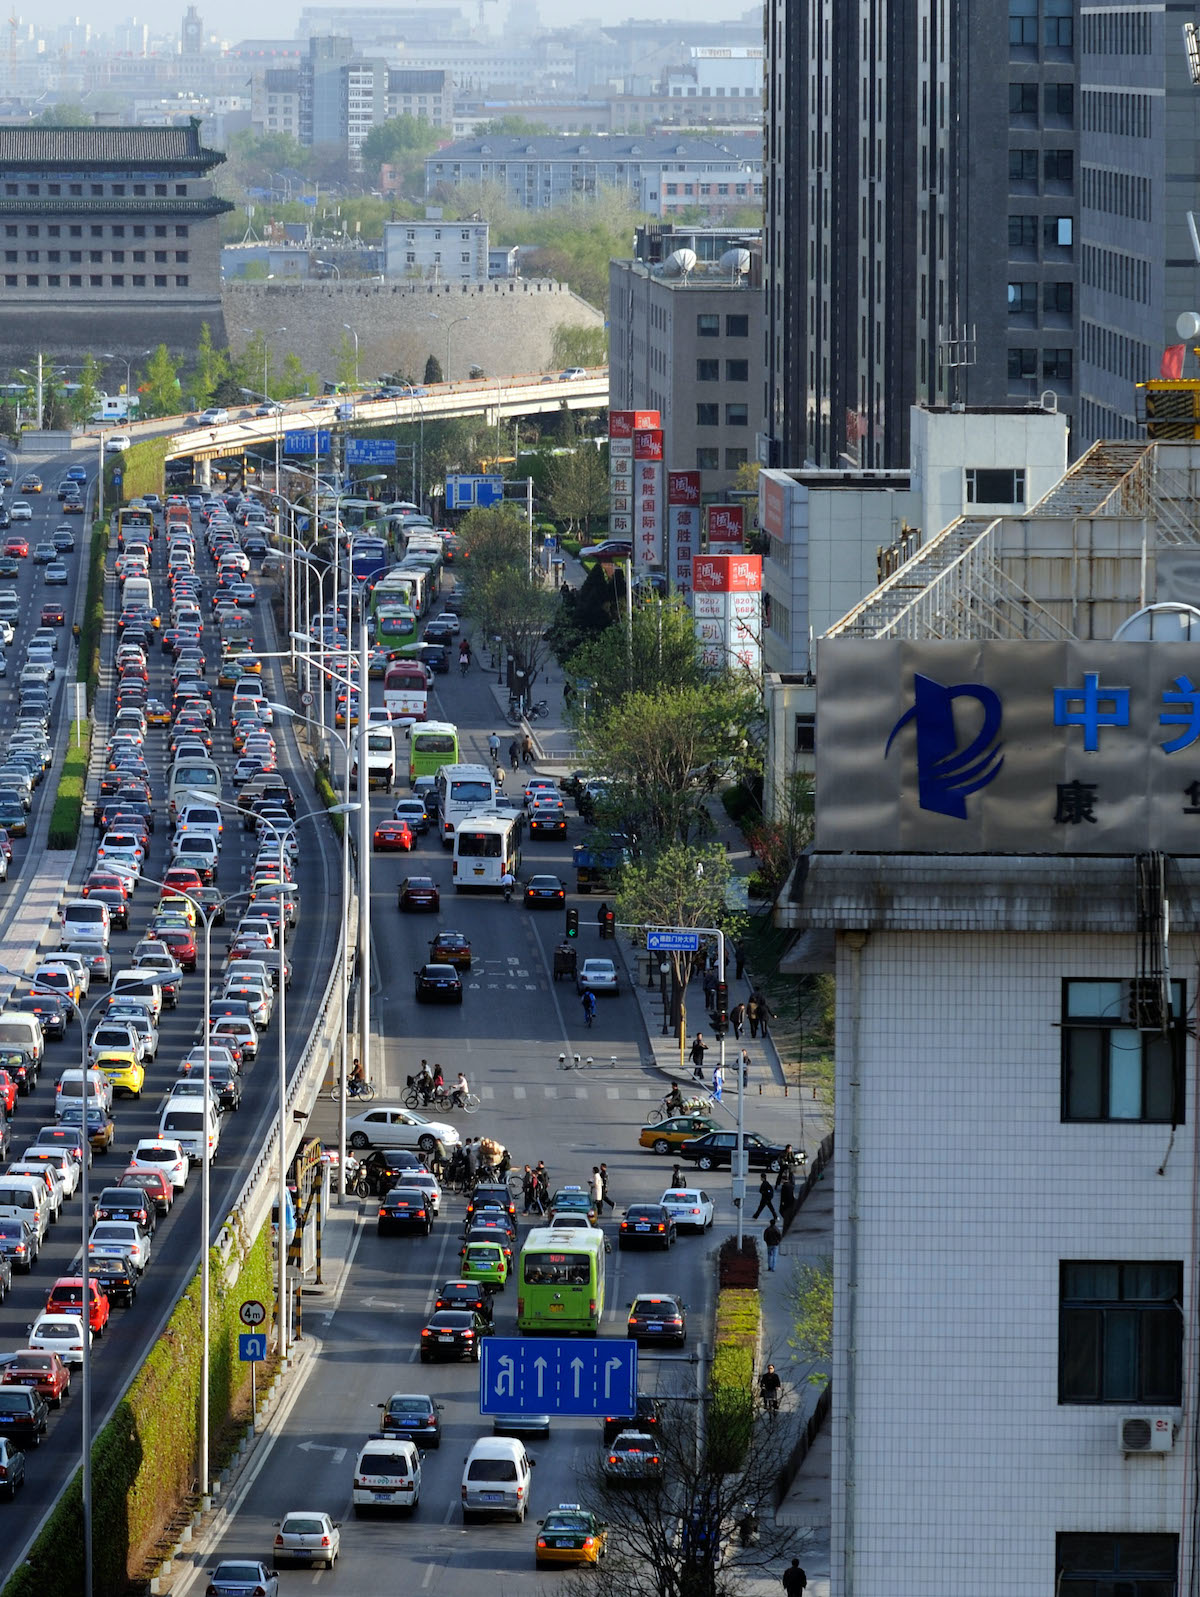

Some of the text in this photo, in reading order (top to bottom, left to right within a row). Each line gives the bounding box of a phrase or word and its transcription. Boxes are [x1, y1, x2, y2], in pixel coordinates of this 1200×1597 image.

[615, 460, 627, 530] 德胜国际
[642, 466, 655, 561] 德胜国际中心
[676, 511, 692, 606] 德胜国际中
